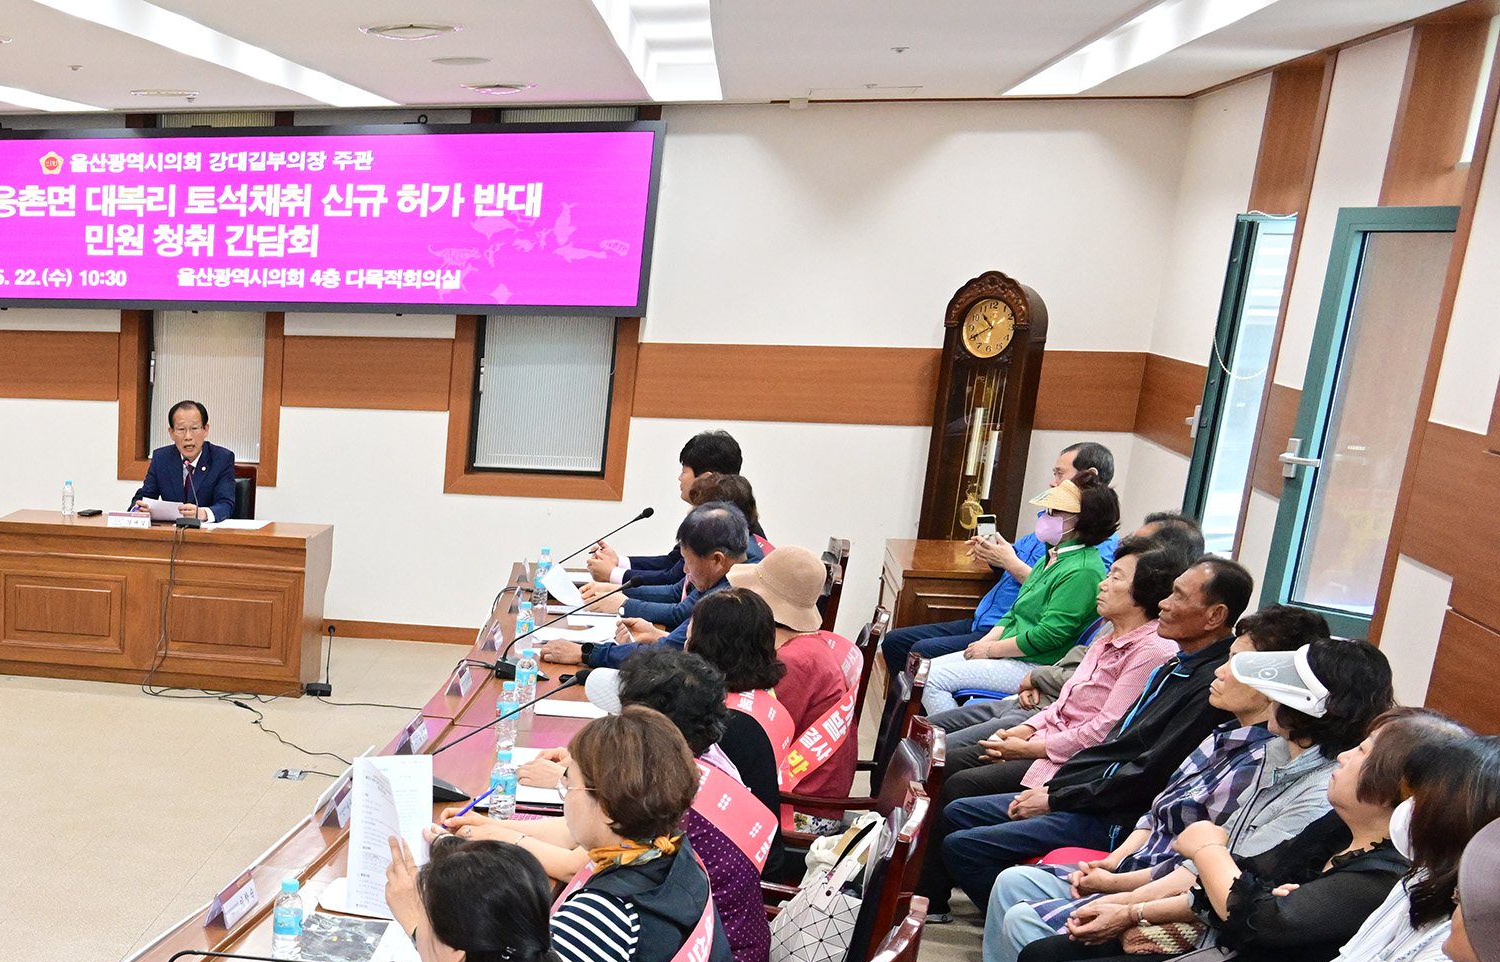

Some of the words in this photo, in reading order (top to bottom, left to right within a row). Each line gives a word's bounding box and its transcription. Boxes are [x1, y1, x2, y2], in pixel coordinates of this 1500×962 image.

[70, 152, 201, 172] 울산광역시의회
[208, 151, 326, 171] 강대길부의장
[332, 150, 374, 171] 주관
[85, 184, 176, 217] 대복리
[184, 183, 312, 217] 토석채취
[321, 183, 388, 217] 신규
[397, 182, 465, 217] 허가
[473, 182, 543, 217] 반대
[85, 224, 145, 256] 민원
[152, 224, 215, 257] 청취
[224, 224, 319, 257] 간담회
[14, 269, 72, 287] 22.(수)
[79, 270, 127, 286] 10:30
[177, 268, 305, 288] 울산광역시의회
[309, 268, 340, 288] 4층
[345, 269, 461, 289] 다목적회의실
